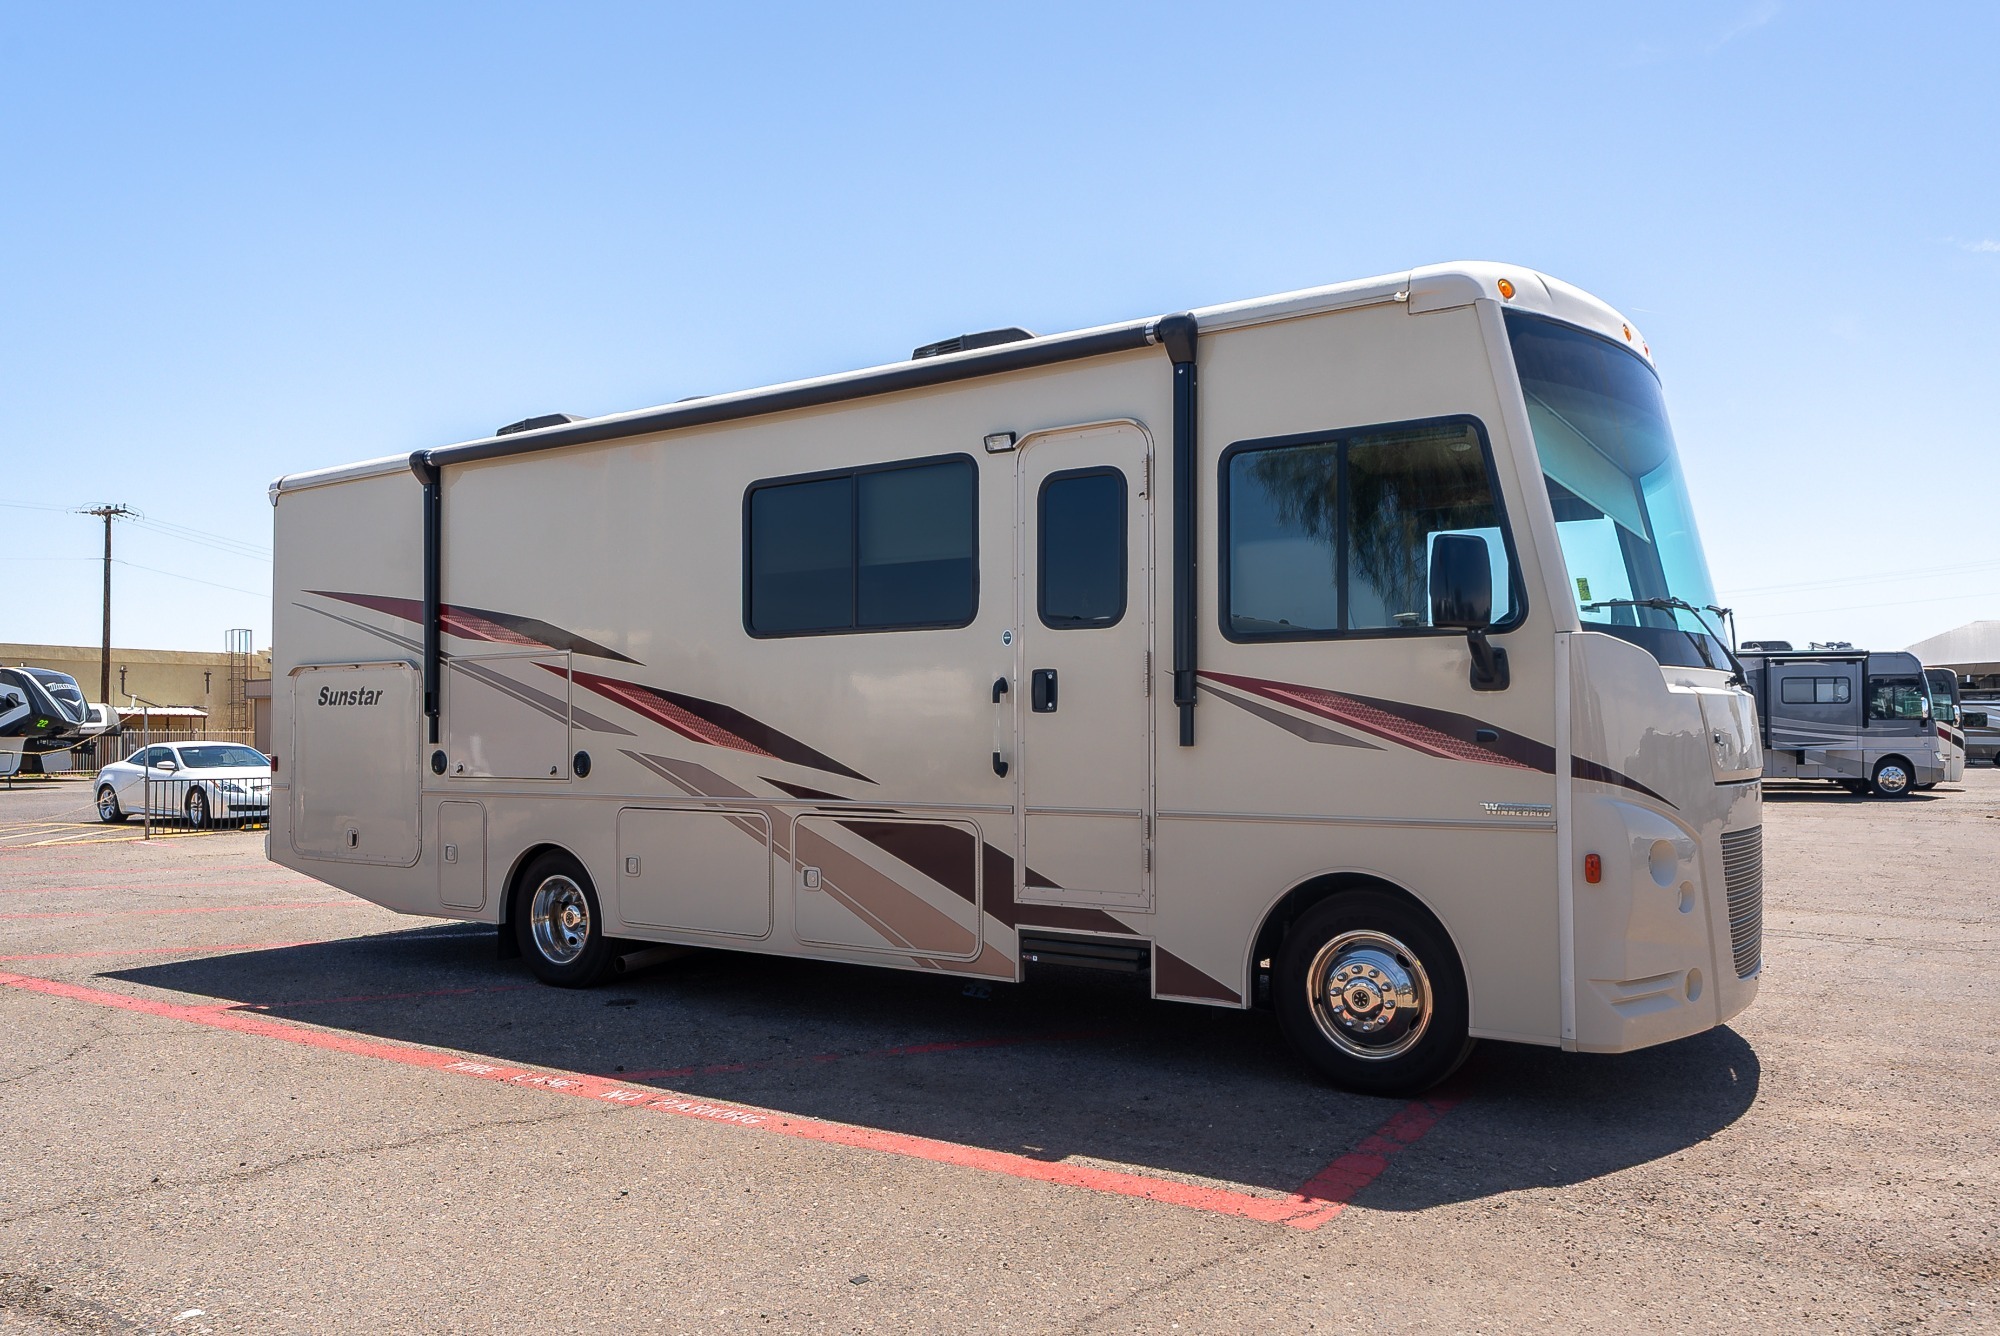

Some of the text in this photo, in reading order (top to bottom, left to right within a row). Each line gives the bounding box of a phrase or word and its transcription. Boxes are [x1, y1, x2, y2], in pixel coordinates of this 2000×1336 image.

[318, 686, 383, 706] Sunstar
[36, 720, 48, 728] 22
[443, 1061, 502, 1075] FIRE
[599, 1089, 644, 1102] NO
[651, 1099, 767, 1125] PARKING
